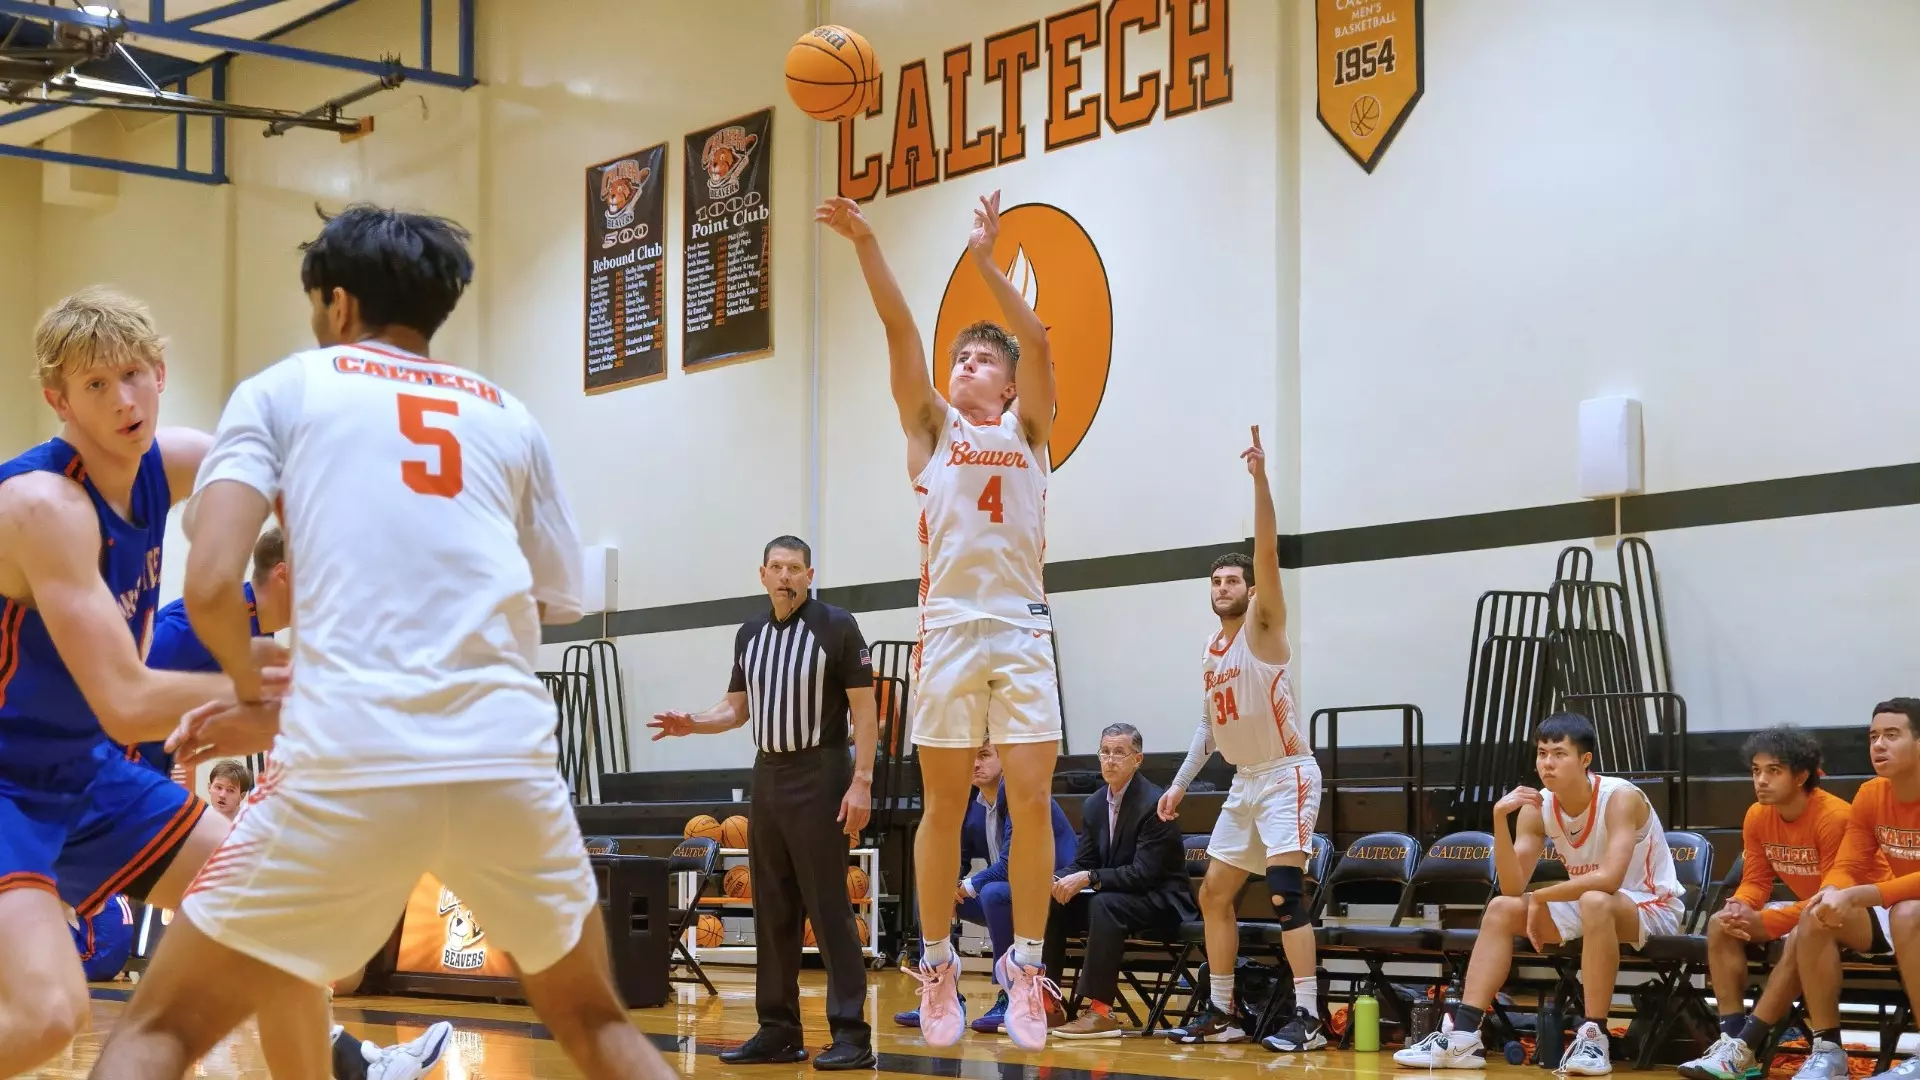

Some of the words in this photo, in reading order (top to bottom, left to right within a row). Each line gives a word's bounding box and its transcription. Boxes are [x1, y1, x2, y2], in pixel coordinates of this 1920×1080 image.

[1334, 11, 1397, 38] BASKETBALL
[1352, 3, 1382, 20] MEN'S
[1333, 35, 1397, 87] 1954
[836, 0, 1233, 204] CALTECH
[696, 192, 760, 221] 1000
[602, 223, 648, 249] 500
[691, 217, 729, 239] Point
[733, 205, 769, 226] Club
[593, 248, 634, 274] Rebound
[637, 242, 662, 260] Club
[333, 355, 505, 409] CALTECH
[397, 392, 463, 498] 5
[977, 475, 1004, 524] 4
[1214, 686, 1240, 725] 34
[672, 846, 709, 858] CALTECH
[1185, 848, 1208, 860] LTEC
[1346, 845, 1407, 860] CALTECH
[1428, 845, 1493, 860] CALTECH
[444, 949, 484, 967] BEAVERS
